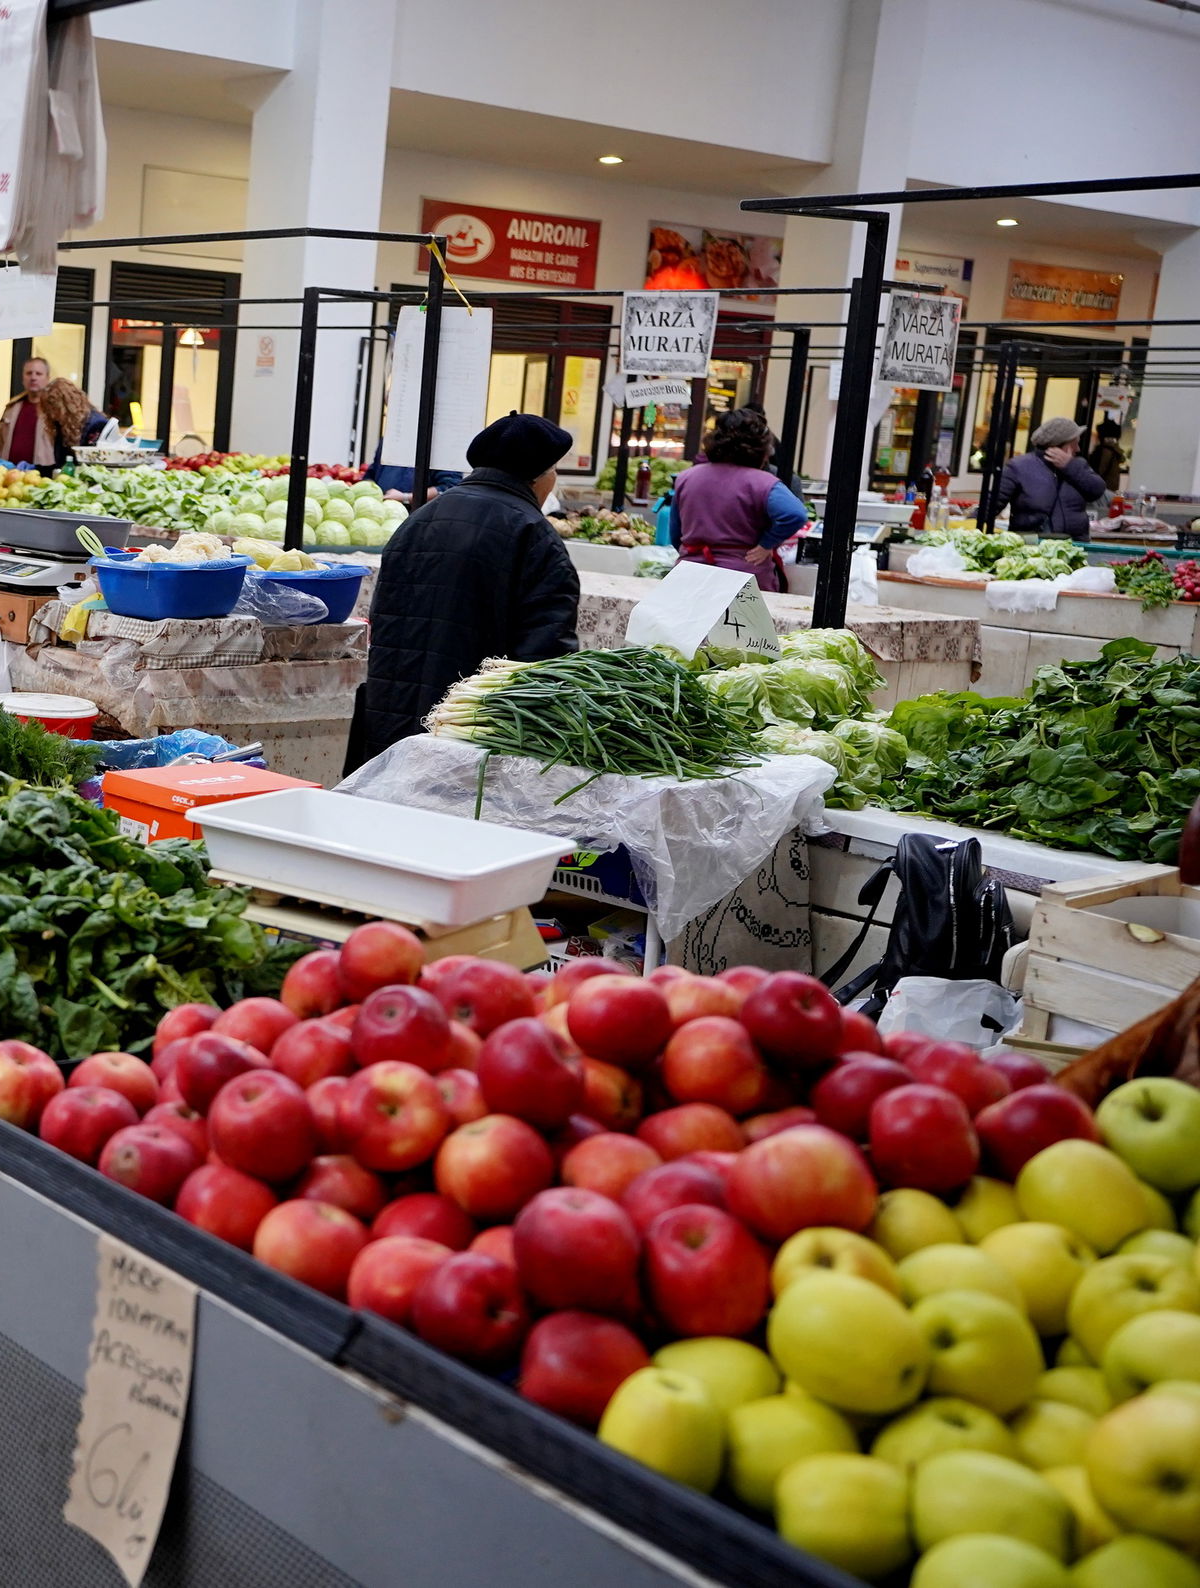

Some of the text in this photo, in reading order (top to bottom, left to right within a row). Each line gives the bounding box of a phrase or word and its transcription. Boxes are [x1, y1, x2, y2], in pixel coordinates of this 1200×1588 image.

[636, 308, 695, 328] VARZĂ
[902, 312, 945, 337] VARZĂ
[628, 333, 705, 353] MURATĂ
[891, 342, 949, 365] MURATĂ
[723, 606, 746, 639] 4
